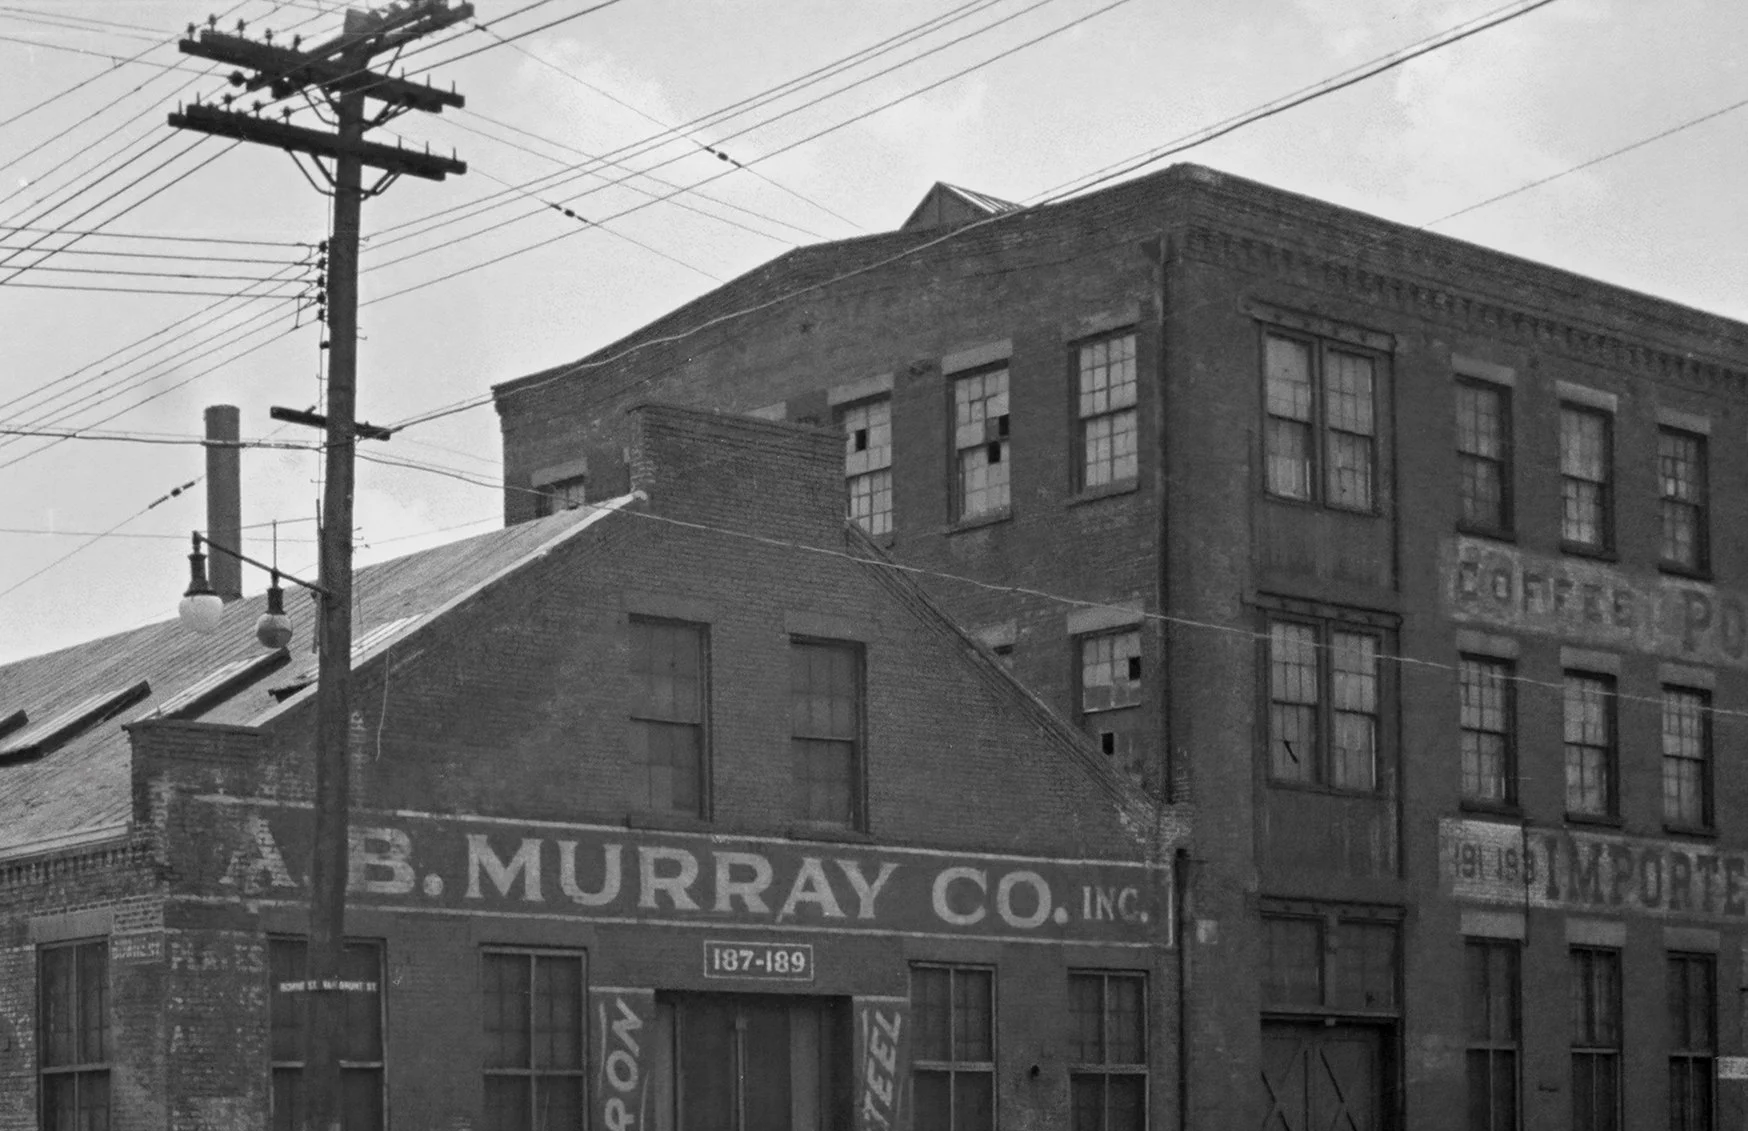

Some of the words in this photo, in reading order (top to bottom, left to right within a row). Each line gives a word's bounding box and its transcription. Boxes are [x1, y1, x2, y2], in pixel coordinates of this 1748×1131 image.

[465, 833, 899, 923] MURRAY
[932, 866, 1069, 929] CO.
[1082, 885, 1149, 924] INC.
[713, 947, 806, 974] 187-189
